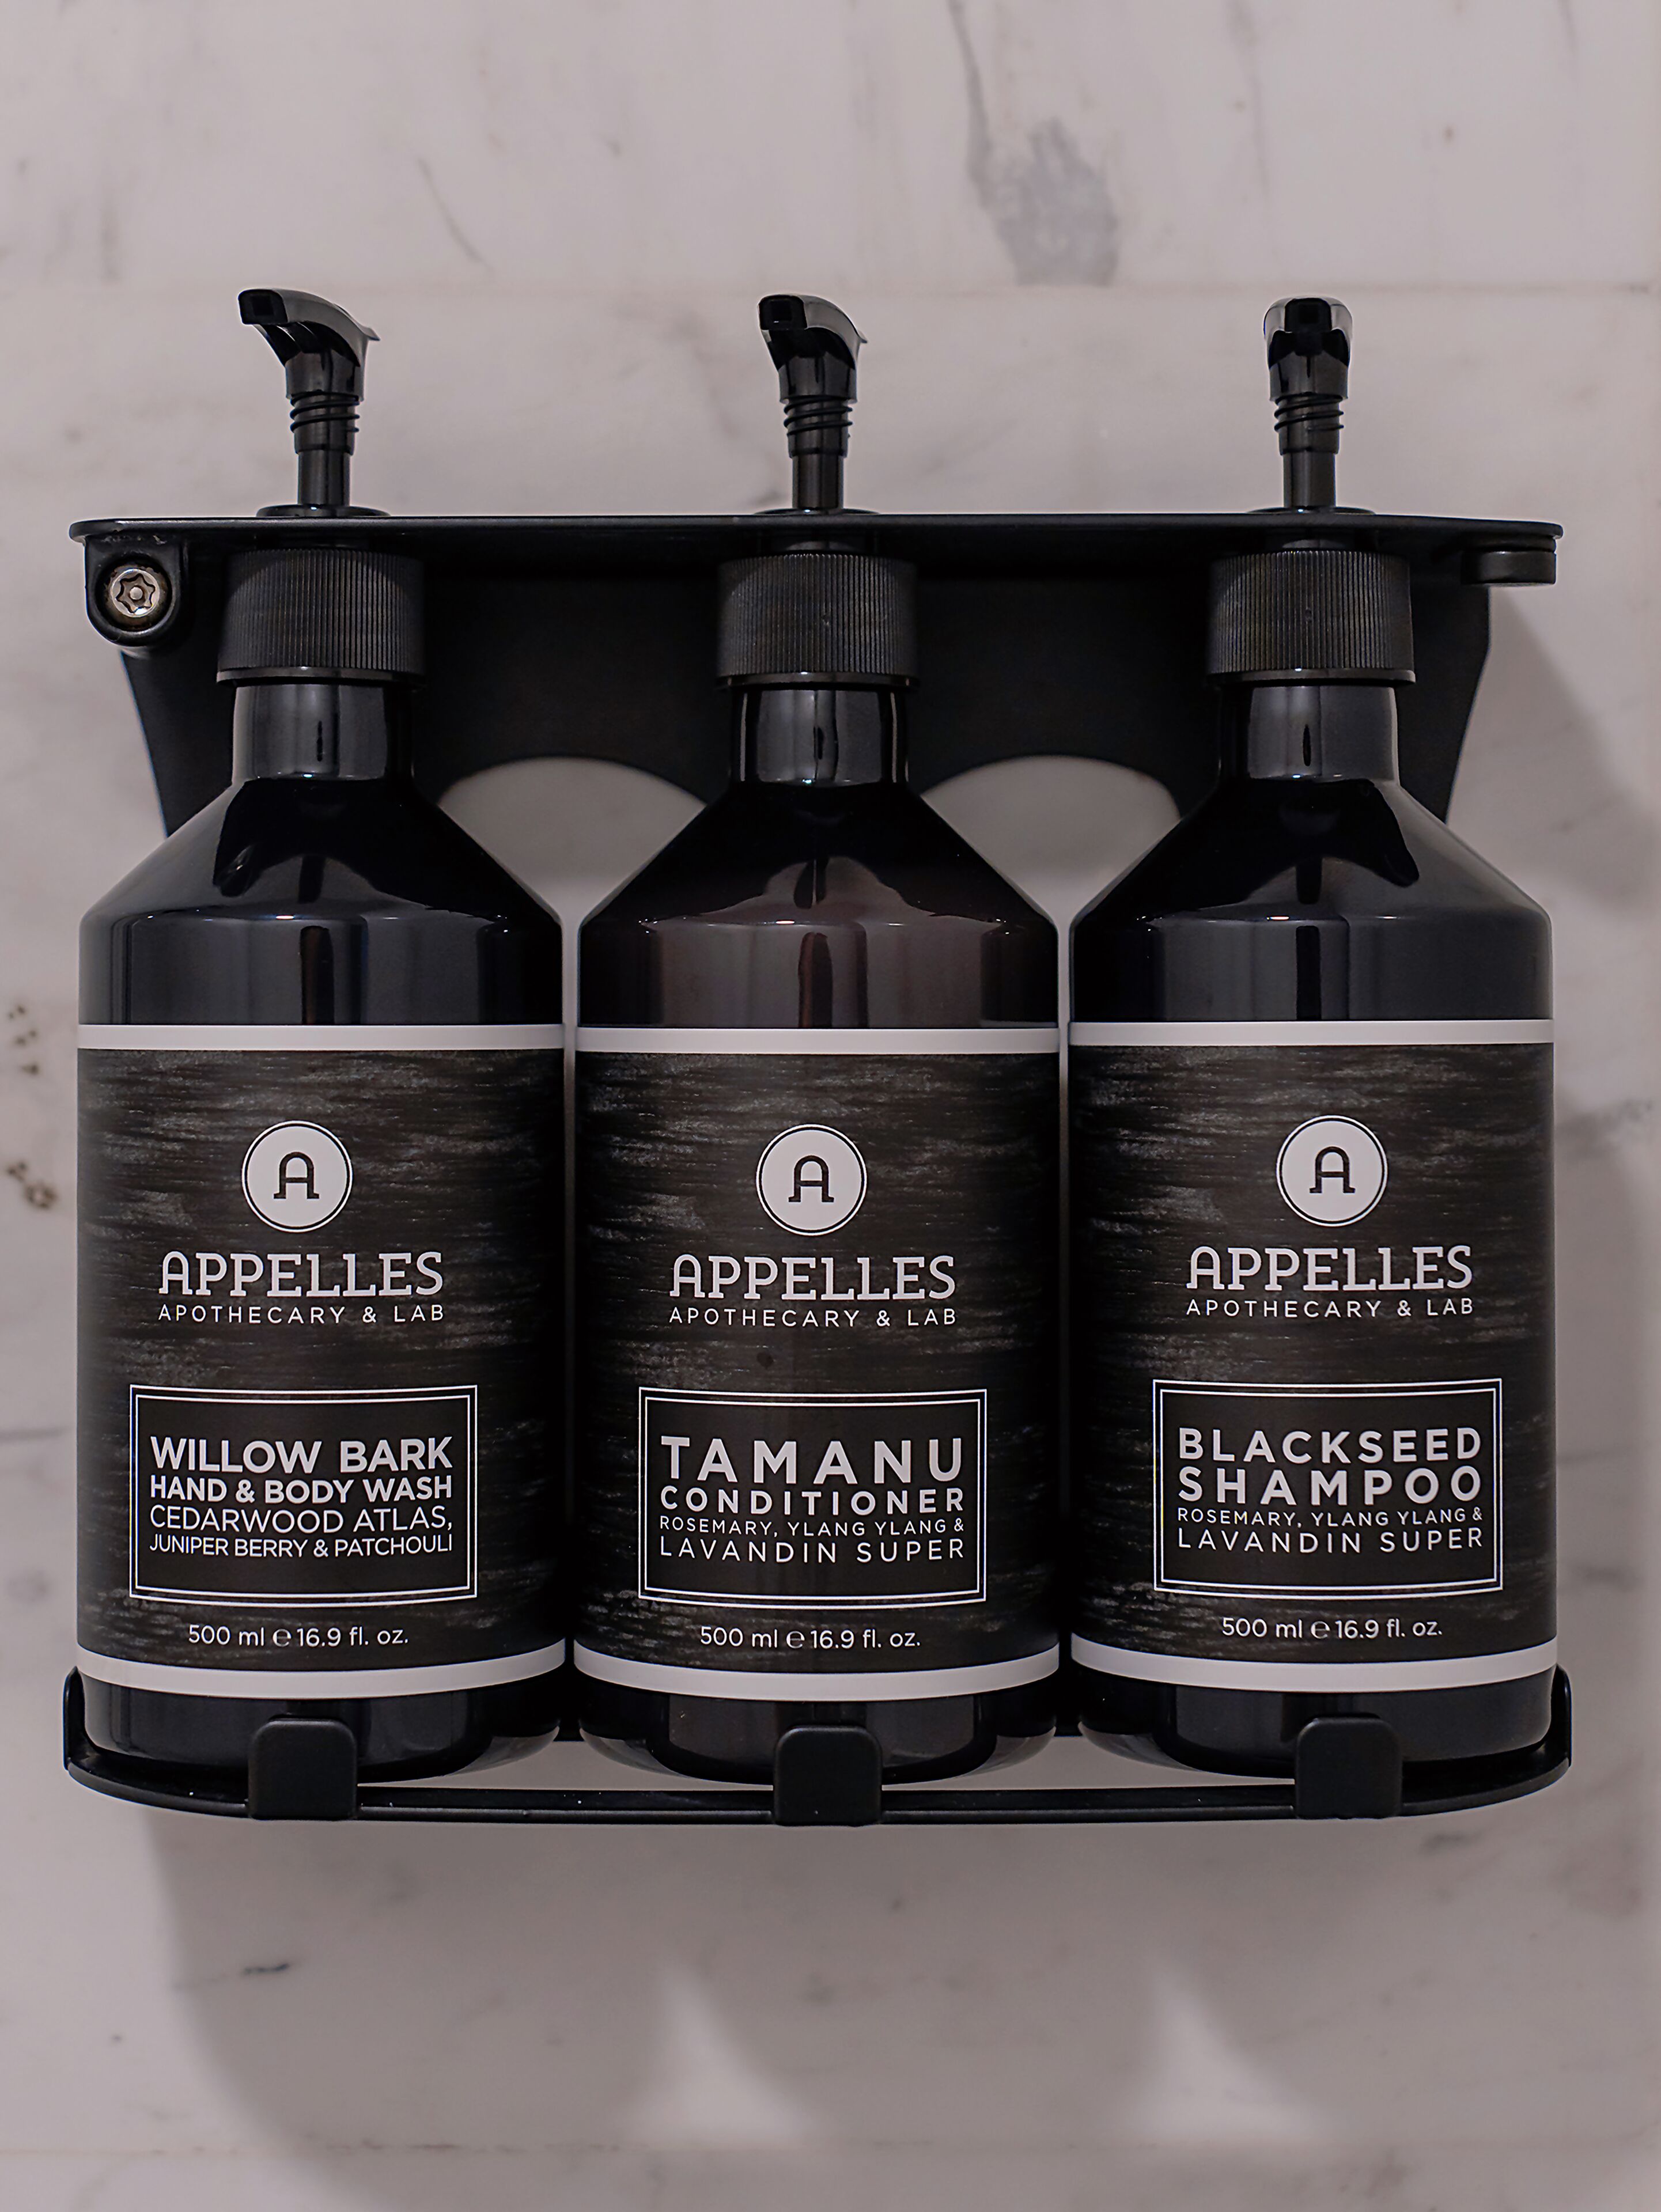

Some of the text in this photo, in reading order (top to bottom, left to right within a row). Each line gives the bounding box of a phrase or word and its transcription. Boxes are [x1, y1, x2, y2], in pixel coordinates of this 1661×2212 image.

[274, 1152, 319, 1199] A
[789, 1156, 834, 1202] A
[1310, 1146, 1355, 1193] A
[159, 1251, 442, 1297] APPELLES
[670, 1254, 955, 1300] APPELLES
[1186, 1245, 1472, 1290] APPELLES
[158, 1304, 443, 1324] APOTHECARY & LAB
[669, 1307, 955, 1327] APOTHECARY & LAB
[1186, 1298, 1472, 1317] APOTHECARY & LAB
[150, 1437, 452, 1474] WILLOW BARK
[1180, 1428, 1480, 1463] BLACKSEED
[661, 1436, 961, 1484] TAMANU
[151, 1475, 451, 1503] HAND & BODY WASH
[1179, 1466, 1480, 1505] SHAMPOO
[661, 1486, 963, 1515] CONDITIONER
[150, 1505, 452, 1533] CEDARWOOD ATLAS,
[660, 1516, 963, 1537] ROSEMARY, YLANG YLANG &
[1178, 1507, 1482, 1528] ROSEMARY, YLANG YLANG &
[150, 1534, 452, 1557] JUNIPER BERRY & PATCHOULI
[661, 1536, 963, 1563] LAVANDIN SUPER
[1179, 1528, 1481, 1553] LAVANDIN SUPER
[189, 1624, 230, 1645] 500
[239, 1627, 264, 1646] ml
[297, 1628, 340, 1647] 16.9
[350, 1627, 368, 1645] fl.
[377, 1630, 408, 1645] oz.
[701, 1626, 743, 1646] 500
[752, 1629, 777, 1647] ml
[811, 1630, 854, 1649] 16.9
[863, 1629, 881, 1648] fl.
[890, 1633, 920, 1647] oz.
[1223, 1617, 1267, 1637] 500
[1276, 1620, 1302, 1638] ml
[1335, 1620, 1379, 1638] 16.9
[1387, 1619, 1405, 1637] fl.
[1413, 1622, 1442, 1636] oz.
